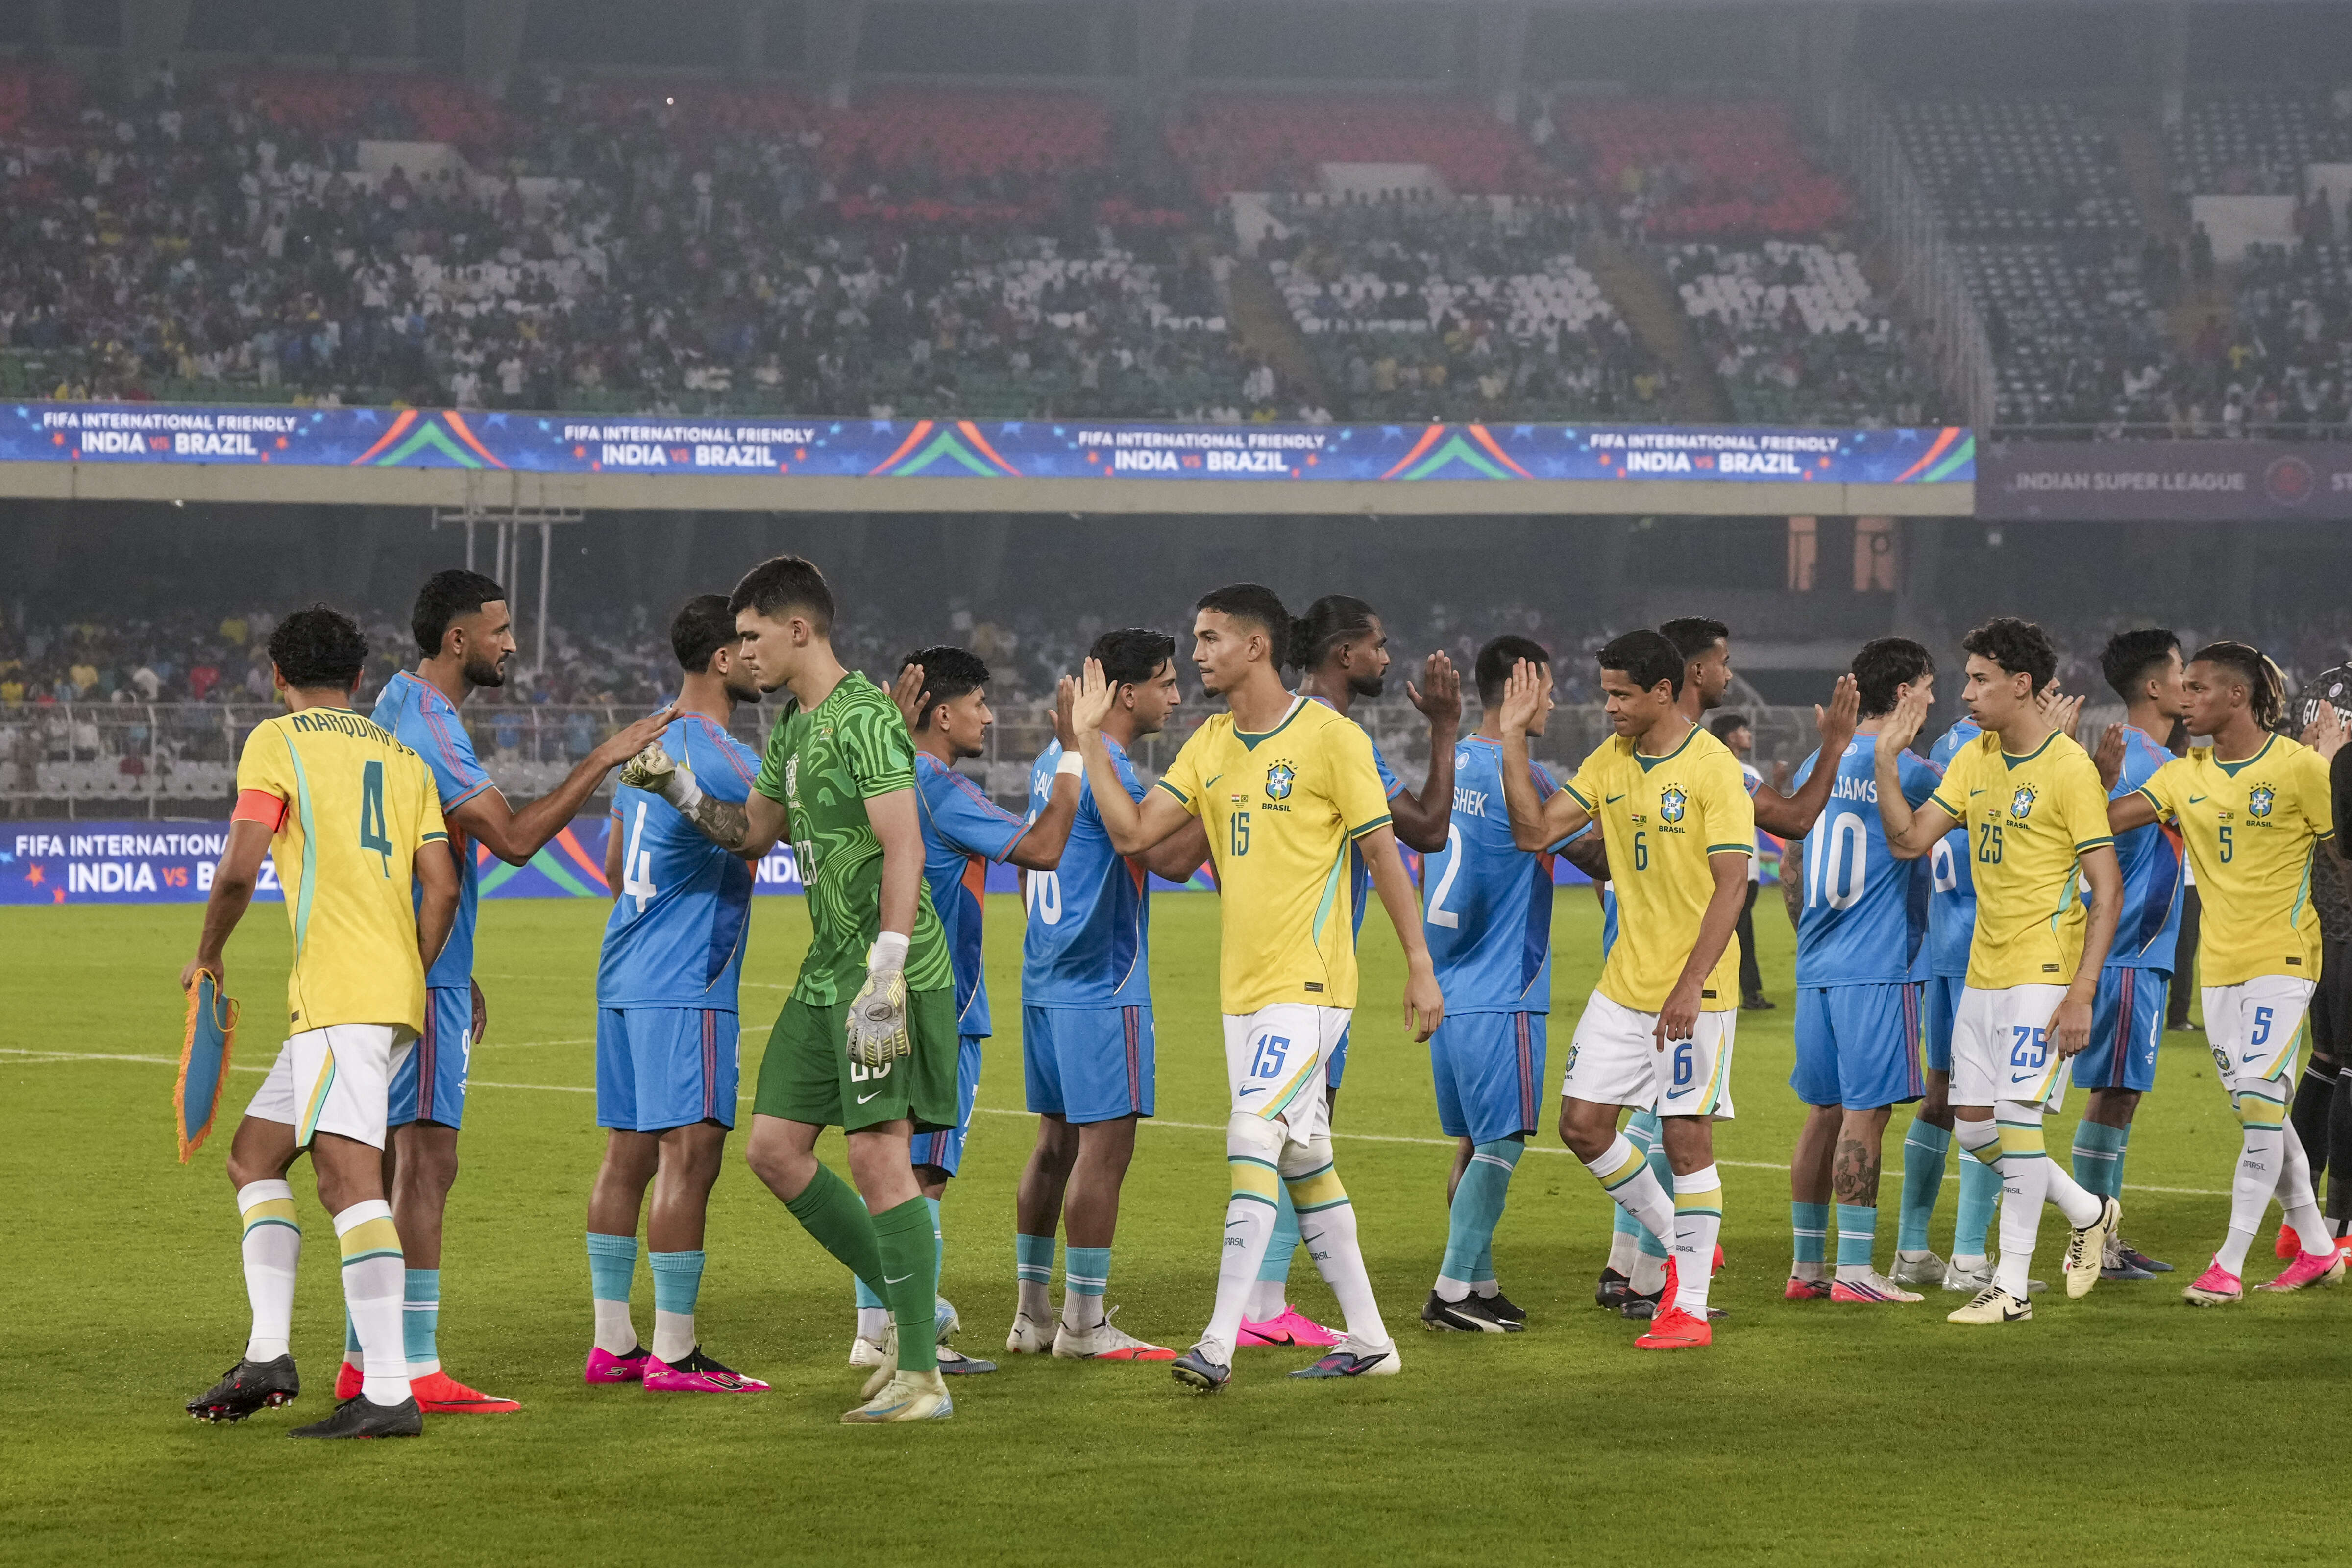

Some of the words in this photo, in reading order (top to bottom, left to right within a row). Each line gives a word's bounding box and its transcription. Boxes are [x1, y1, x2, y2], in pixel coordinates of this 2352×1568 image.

[43, 412, 79, 428] FIFA
[82, 413, 214, 431] INTERNATIONAL
[217, 415, 296, 432] FRIENDLY
[564, 425, 601, 441] FIFA
[603, 426, 735, 443] INTERNATIONAL
[737, 428, 815, 443] FRIENDLY
[81, 431, 146, 454] INDIA
[175, 433, 258, 455] BRAZIL
[602, 444, 667, 466] INDIA
[695, 445, 777, 466] BRAZIL
[1078, 431, 1113, 446] FIFA
[1116, 432, 1245, 448] INTERNATIONAL
[1248, 434, 1325, 449] FRIENDLY
[1590, 433, 1626, 449] FIFA
[1628, 434, 1757, 450] INTERNATIONAL
[1761, 436, 1839, 451] FRIENDLY
[1115, 450, 1179, 471] INDIA
[1207, 451, 1289, 472] BRAZIL
[1627, 451, 1691, 472] INDIA
[1719, 452, 1801, 474] BRAZIL
[2016, 472, 2090, 490] INDIAN
[2093, 472, 2158, 490] SUPER
[2163, 473, 2244, 490] LEAGUE
[1262, 803, 1291, 812] BRASIL
[1452, 786, 1489, 818] SHEK
[361, 760, 392, 879] 4
[1230, 812, 1250, 856] 15
[1659, 825, 1686, 833] BRASIL
[2006, 819, 2031, 830] BRASIL
[15, 835, 65, 857] FIFA
[70, 834, 229, 856] INTERNATION
[624, 801, 657, 913] 4
[1634, 831, 1648, 871] 6
[1809, 809, 1867, 910] 10
[1979, 823, 2003, 864] 25
[2219, 826, 2233, 863] 5
[68, 862, 157, 893] INDIA
[161, 867, 189, 888] VS
[795, 840, 818, 886] 23
[1427, 822, 1462, 929] 2
[2150, 1010, 2159, 1047] 8
[2251, 1007, 2274, 1045] 5
[462, 1029, 470, 1073] 9
[1250, 1034, 1290, 1078] 15
[2010, 1026, 2047, 1069] 25
[1673, 1043, 1692, 1085] 6
[2243, 1160, 2266, 1171] BRASIL
